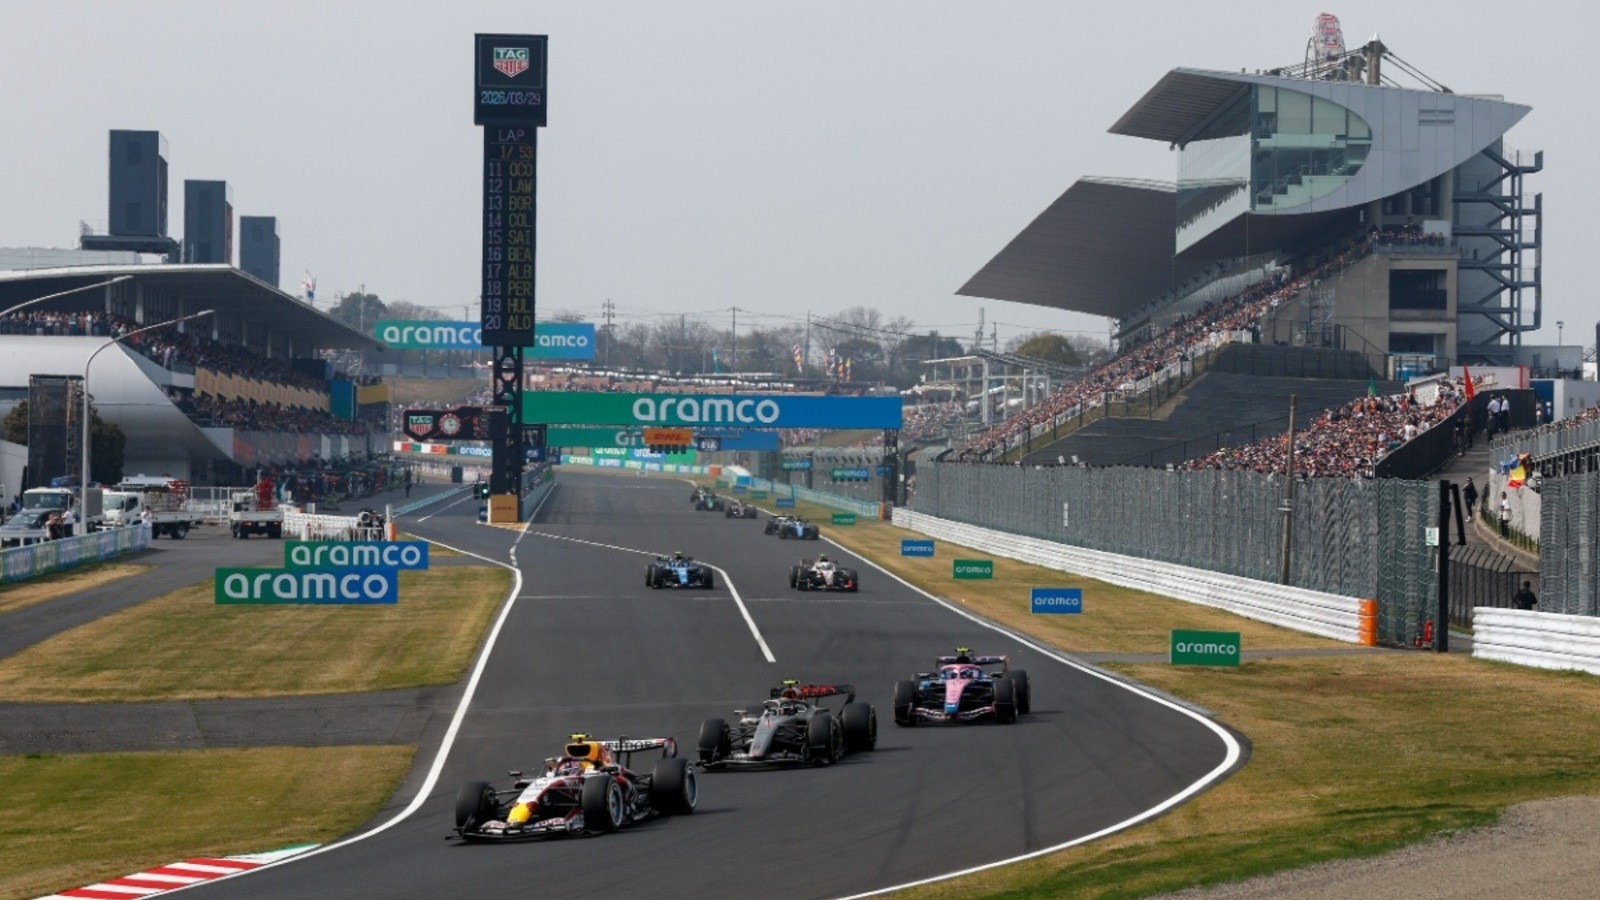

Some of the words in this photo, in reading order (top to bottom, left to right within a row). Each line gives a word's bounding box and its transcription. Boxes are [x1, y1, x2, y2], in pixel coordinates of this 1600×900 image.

[498, 50, 526, 58] TAG
[481, 90, 541, 105] 2026/03/29
[498, 129, 525, 142] LAP
[488, 162, 502, 176] 11
[510, 162, 532, 176] OCO
[488, 179, 502, 193] 12
[509, 179, 532, 193] LAW
[488, 196, 502, 210] 13
[509, 196, 532, 210] BOR
[488, 212, 502, 227] 14
[508, 212, 532, 227] COL
[488, 230, 502, 244] 15
[508, 230, 530, 244] SAI
[488, 247, 502, 261] 16
[508, 247, 532, 261] BEA
[488, 264, 501, 278] 17
[508, 264, 532, 278] ALB
[487, 281, 501, 296] 18
[508, 281, 532, 296] PER
[487, 298, 501, 313] 19
[508, 298, 530, 313] HUL
[485, 314, 501, 330] 20
[508, 314, 531, 330] ALO
[632, 397, 780, 424] aramco
[291, 544, 421, 566] aramco
[955, 566, 991, 575] aramco
[224, 573, 389, 599] aramco
[1034, 595, 1080, 606] aramco
[1176, 641, 1237, 656] aramco
